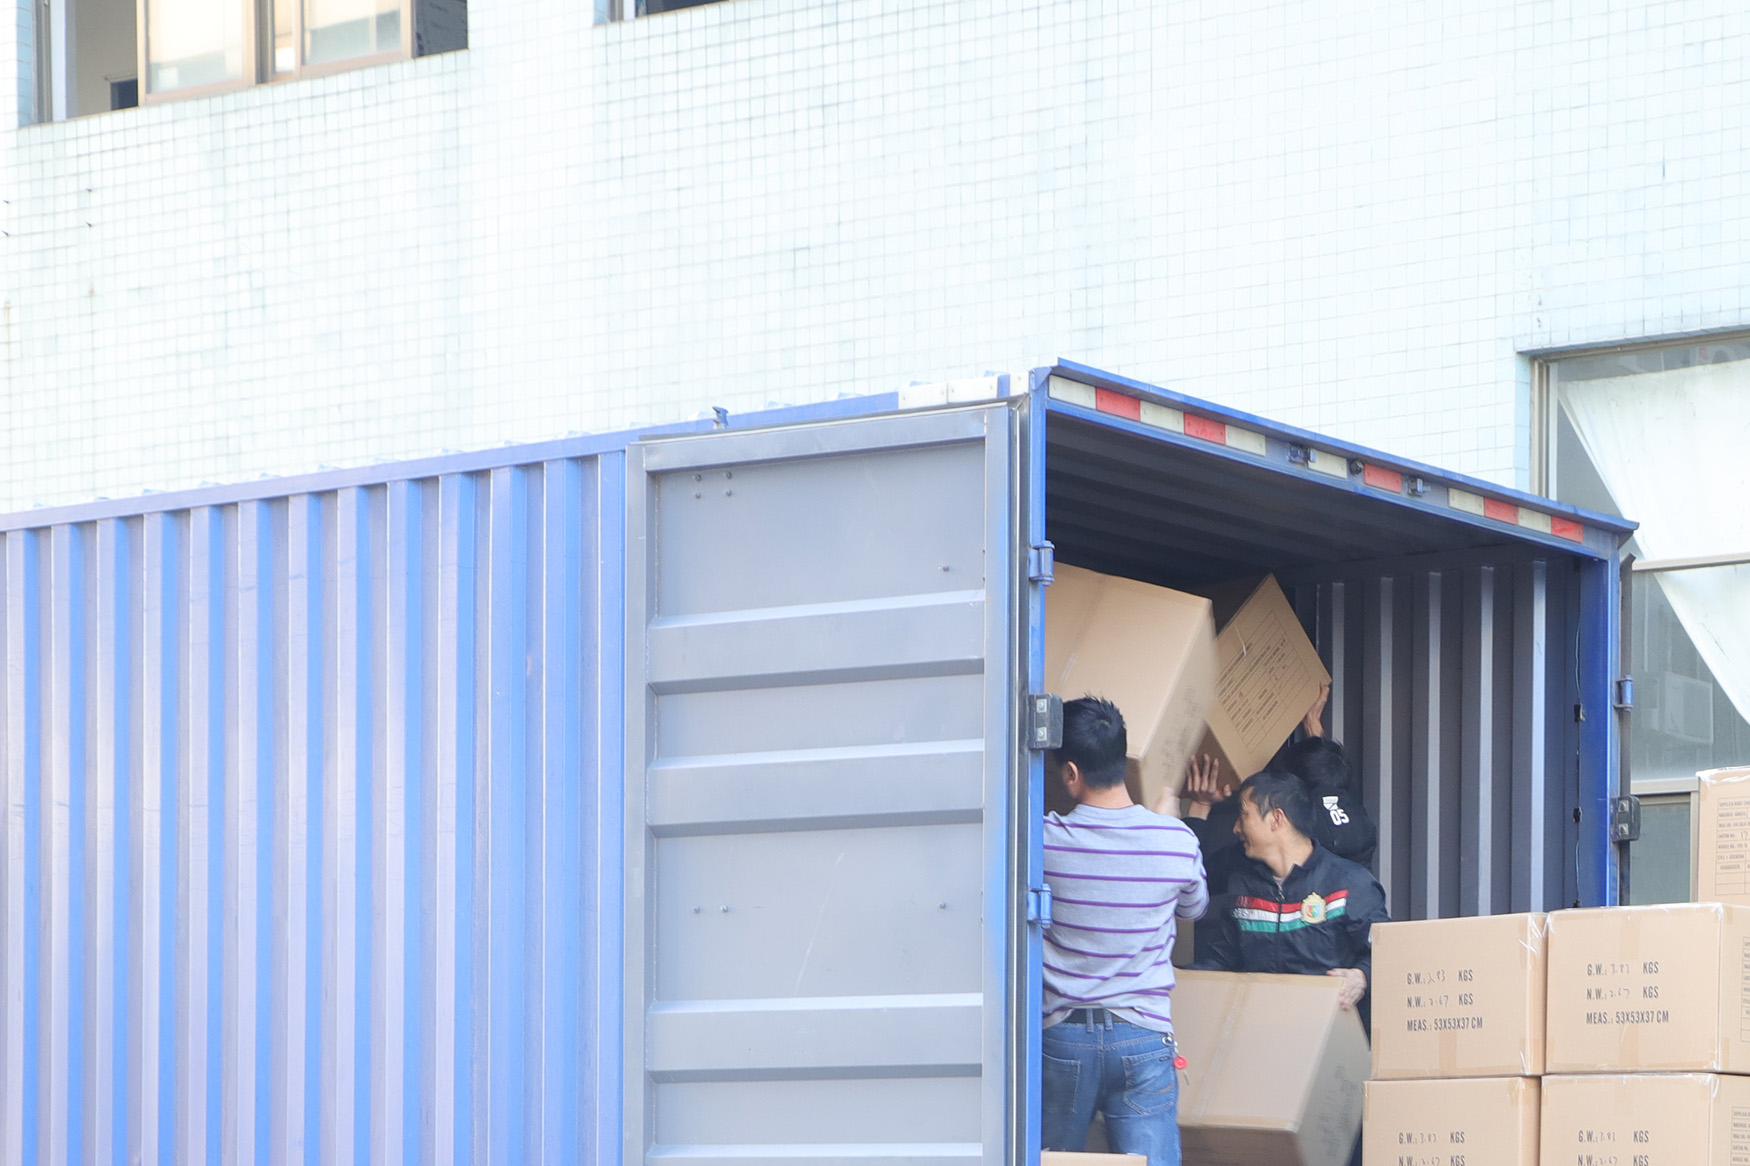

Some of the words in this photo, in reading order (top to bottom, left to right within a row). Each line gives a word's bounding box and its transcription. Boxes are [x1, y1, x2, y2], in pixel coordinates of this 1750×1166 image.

[1330, 809, 1349, 826] 05
[1587, 963, 1607, 976] G.W.:
[1643, 962, 1659, 974] KGS
[1407, 973, 1425, 984] G.W.:
[1458, 969, 1473, 981] KGS
[1587, 988, 1607, 1000] N.W.:
[1643, 986, 1659, 999] KGS
[1407, 996, 1426, 1008] N.W.:
[1459, 993, 1473, 1005] KGS
[1407, 1020, 1431, 1031] MEAS.:
[1434, 1017, 1469, 1030] 53X53X37
[1471, 1017, 1482, 1029] CM
[1587, 1012, 1613, 1025] MEAS.:
[1616, 1011, 1654, 1024] 53X53X37
[1656, 1010, 1669, 1023] CM
[1399, 1132, 1417, 1144] G.W.:
[1450, 1132, 1465, 1143] KGS
[1579, 1130, 1598, 1143] G.W.:
[1634, 1130, 1649, 1143] KGS
[1399, 1156, 1418, 1166] N.W.:
[1450, 1155, 1465, 1166] KGS
[1578, 1155, 1598, 1166] N.W.:
[1633, 1155, 1649, 1166] KGS
